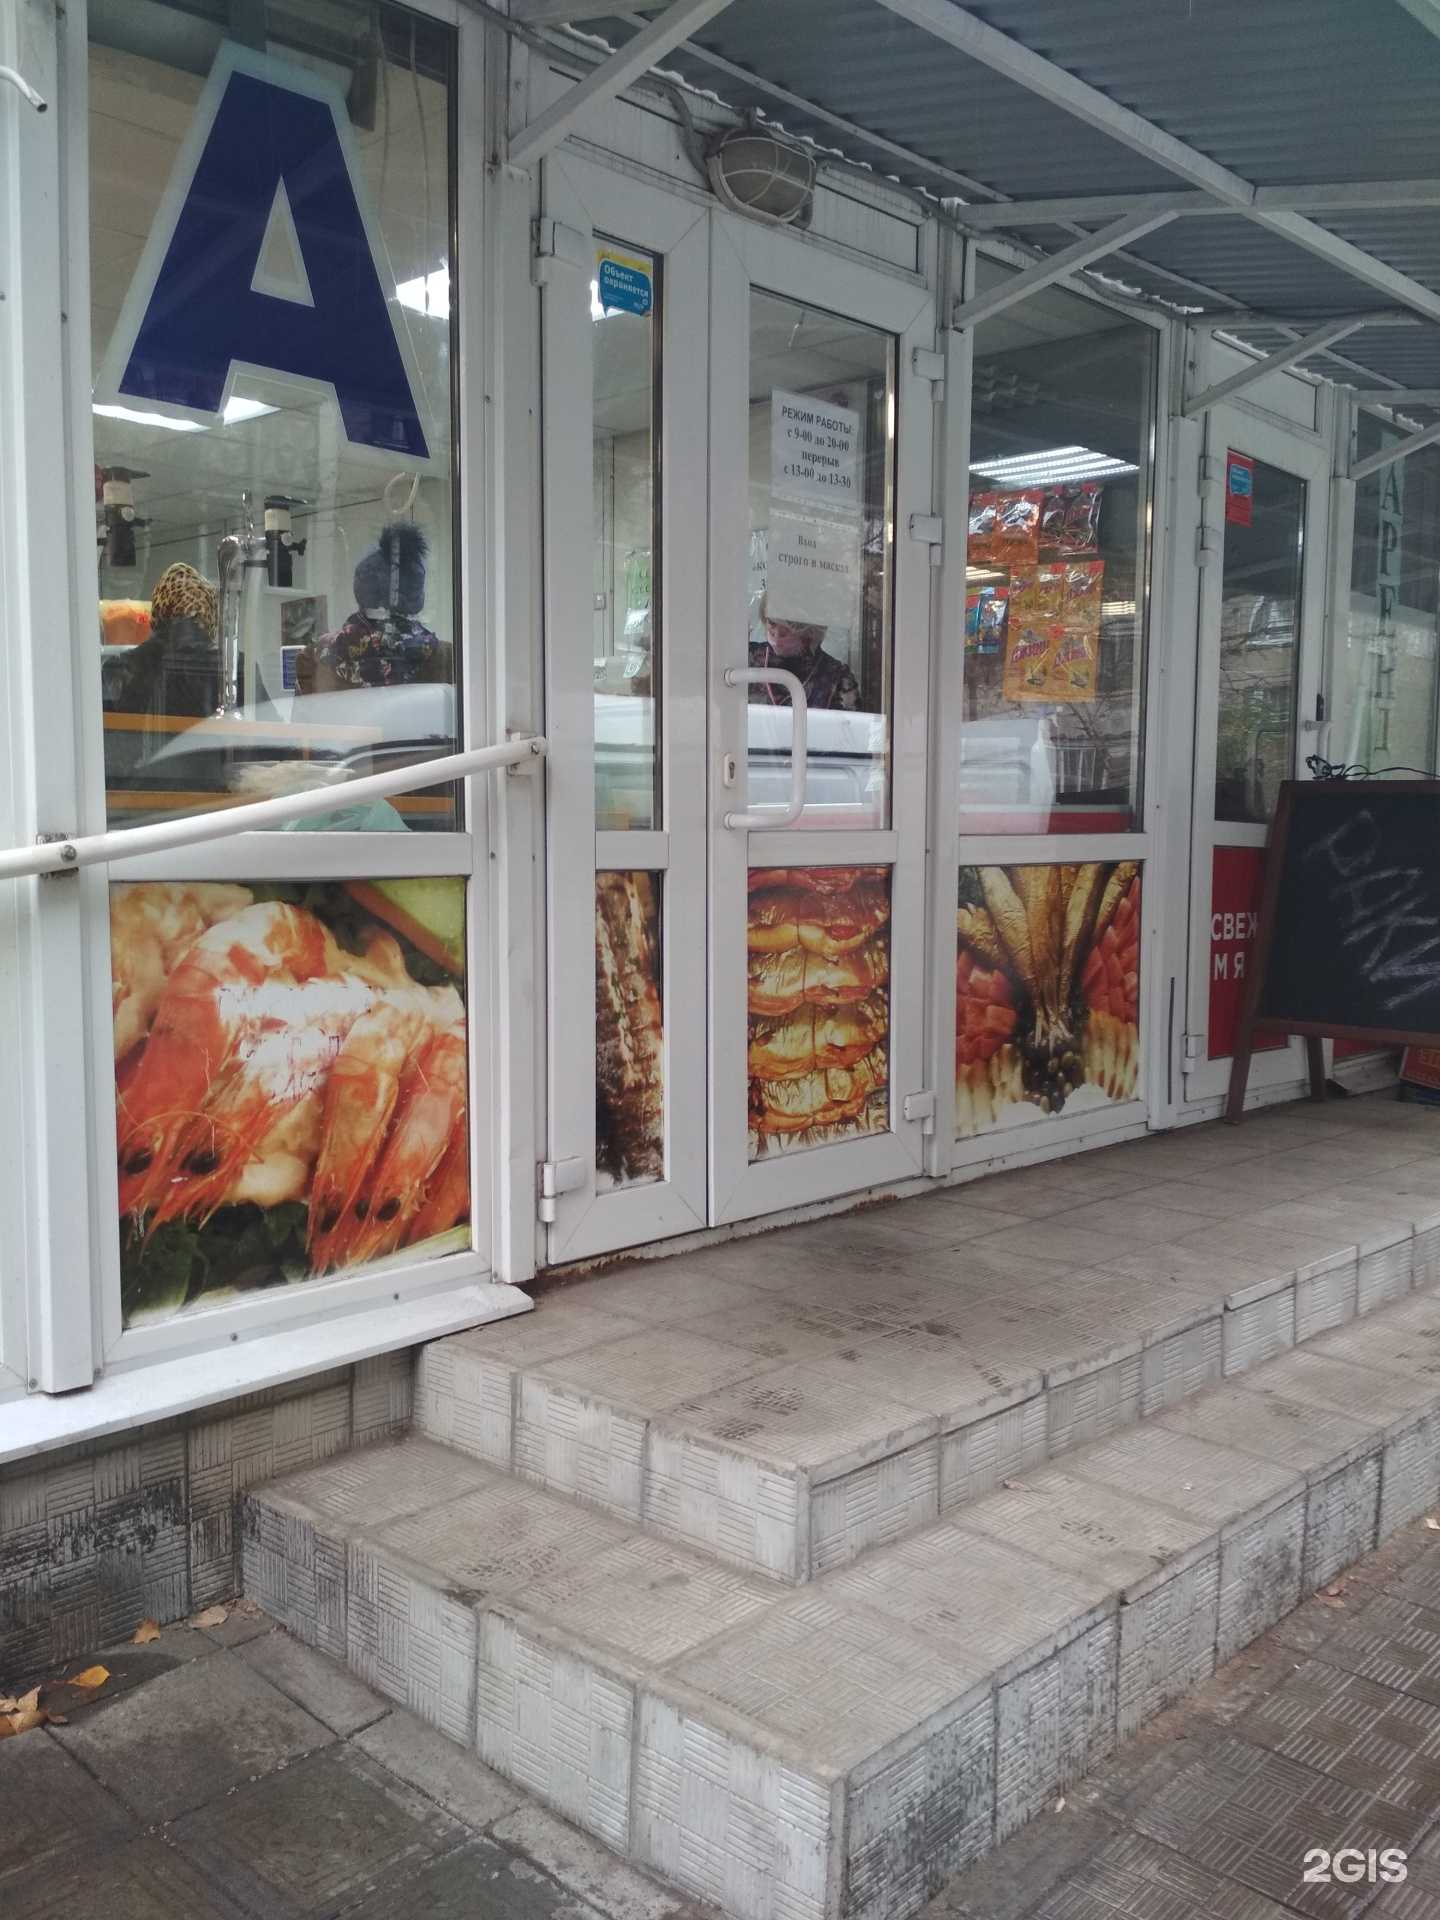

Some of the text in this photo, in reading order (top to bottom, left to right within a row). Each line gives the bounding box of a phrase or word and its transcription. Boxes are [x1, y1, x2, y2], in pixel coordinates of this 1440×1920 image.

[115, 67, 433, 462] А
[782, 405, 814, 425] РЕЖИМ
[794, 427, 813, 443] 9-00
[815, 436, 825, 446] до
[827, 435, 850, 452] 20-00
[802, 450, 840, 468] перерыв
[791, 463, 815, 479] 13-00
[816, 474, 827, 483] до
[830, 473, 852, 489] 13-30
[778, 552, 809, 567] строго
